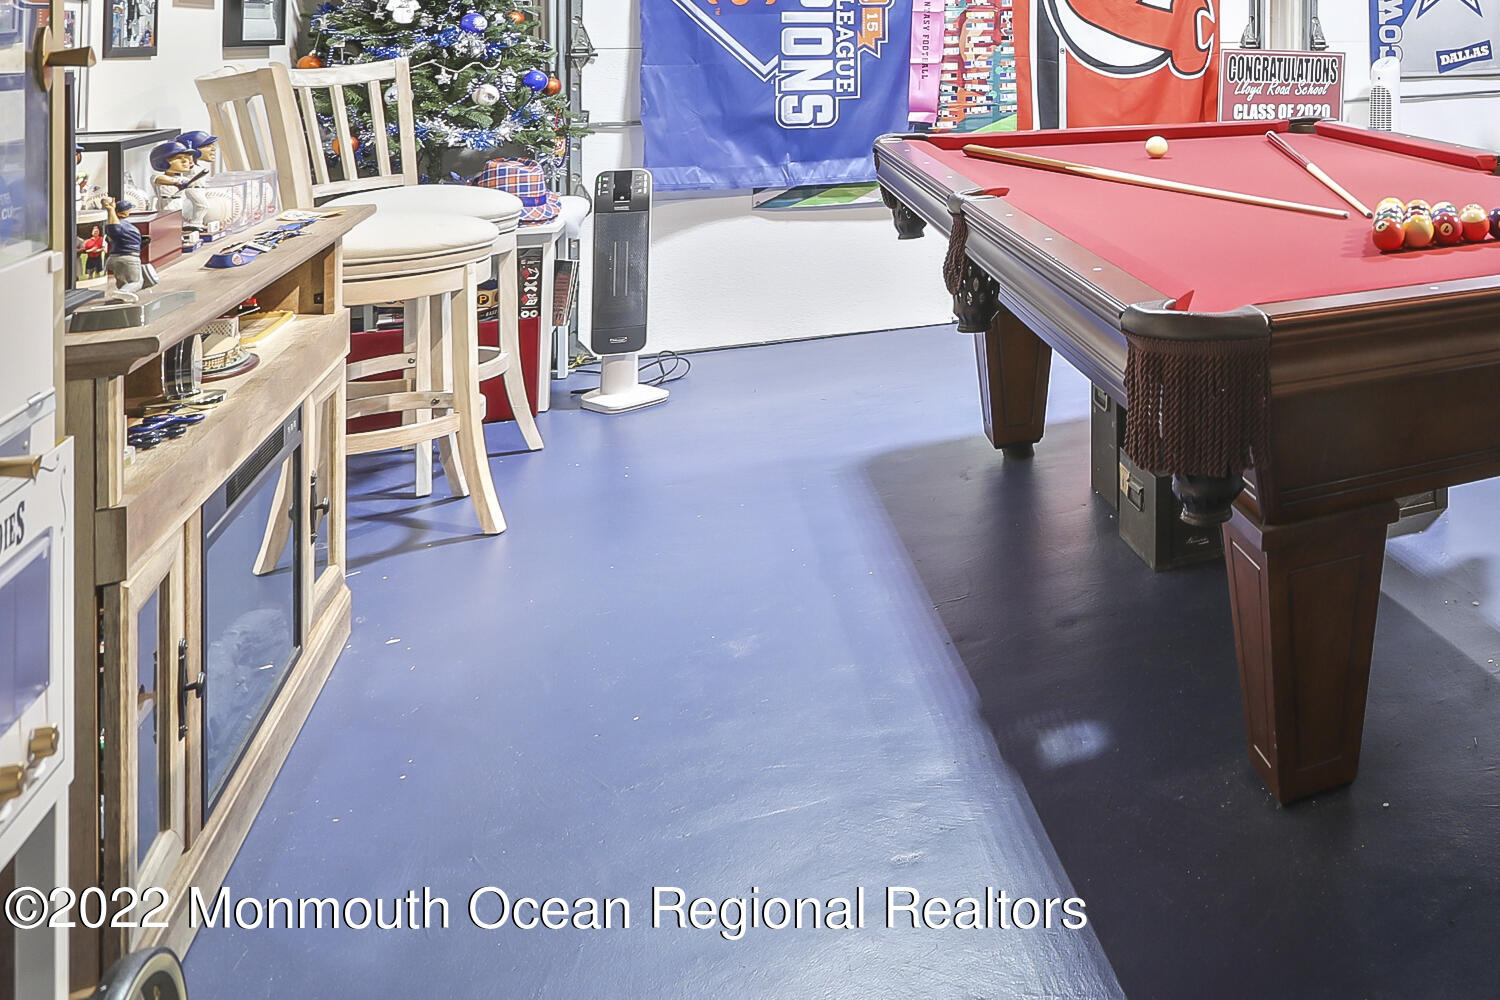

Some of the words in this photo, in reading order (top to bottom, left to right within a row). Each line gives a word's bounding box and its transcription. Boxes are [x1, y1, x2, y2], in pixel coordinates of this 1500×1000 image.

[866, 13, 878, 32] 15
[1439, 45, 1490, 66] DALLAS
[1227, 55, 1338, 84] CONGRATULATIONS
[1234, 80, 1263, 101] Lloyd
[1266, 80, 1294, 96] Road
[1294, 81, 1331, 96] School
[1233, 104, 1276, 120] CLASS
[1278, 104, 1295, 119] OF
[1296, 104, 1331, 118] 2020
